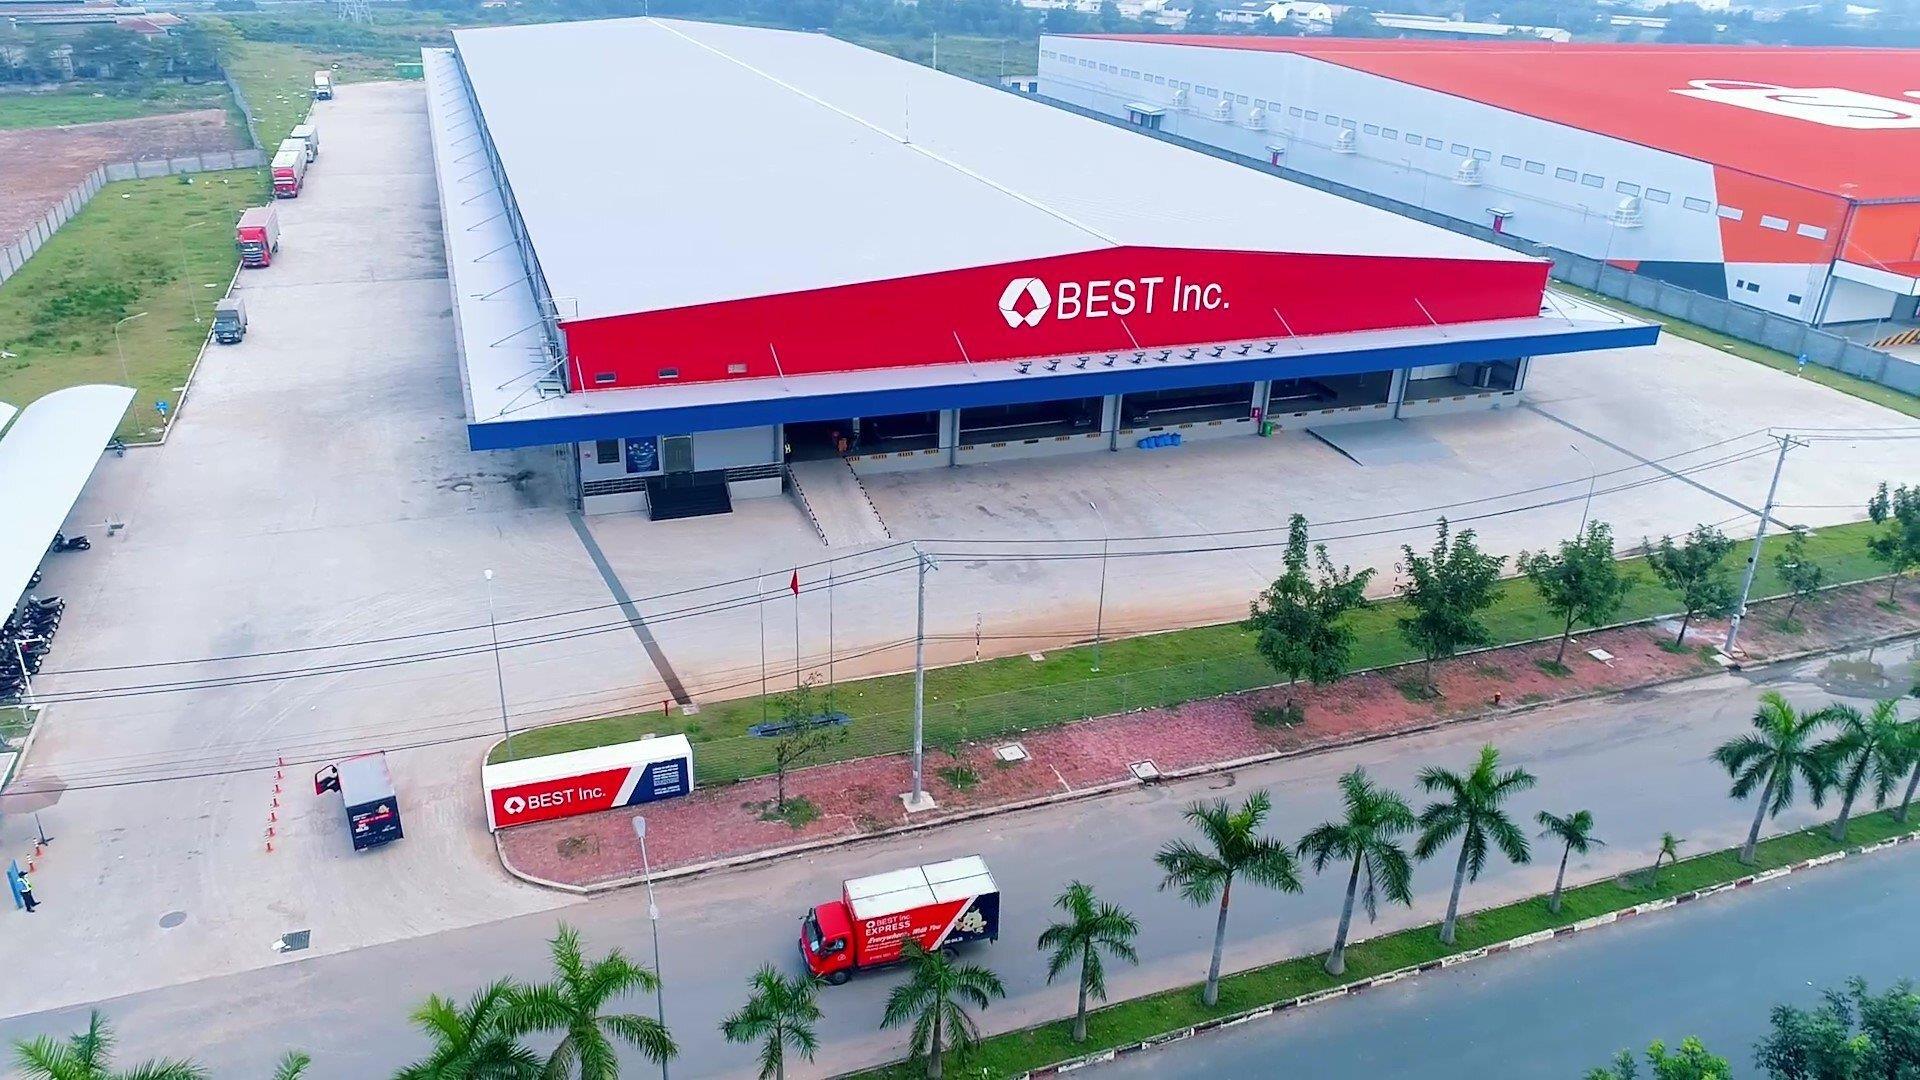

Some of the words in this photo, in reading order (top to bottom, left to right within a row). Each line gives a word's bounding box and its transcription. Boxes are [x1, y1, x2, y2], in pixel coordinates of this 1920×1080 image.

[1057, 277, 1164, 320] BEST
[1173, 276, 1230, 312] Inc.
[528, 789, 574, 810] BEST
[579, 787, 606, 801] Inc.
[865, 920, 911, 936] EXPRESS
[876, 916, 897, 927] BEST
